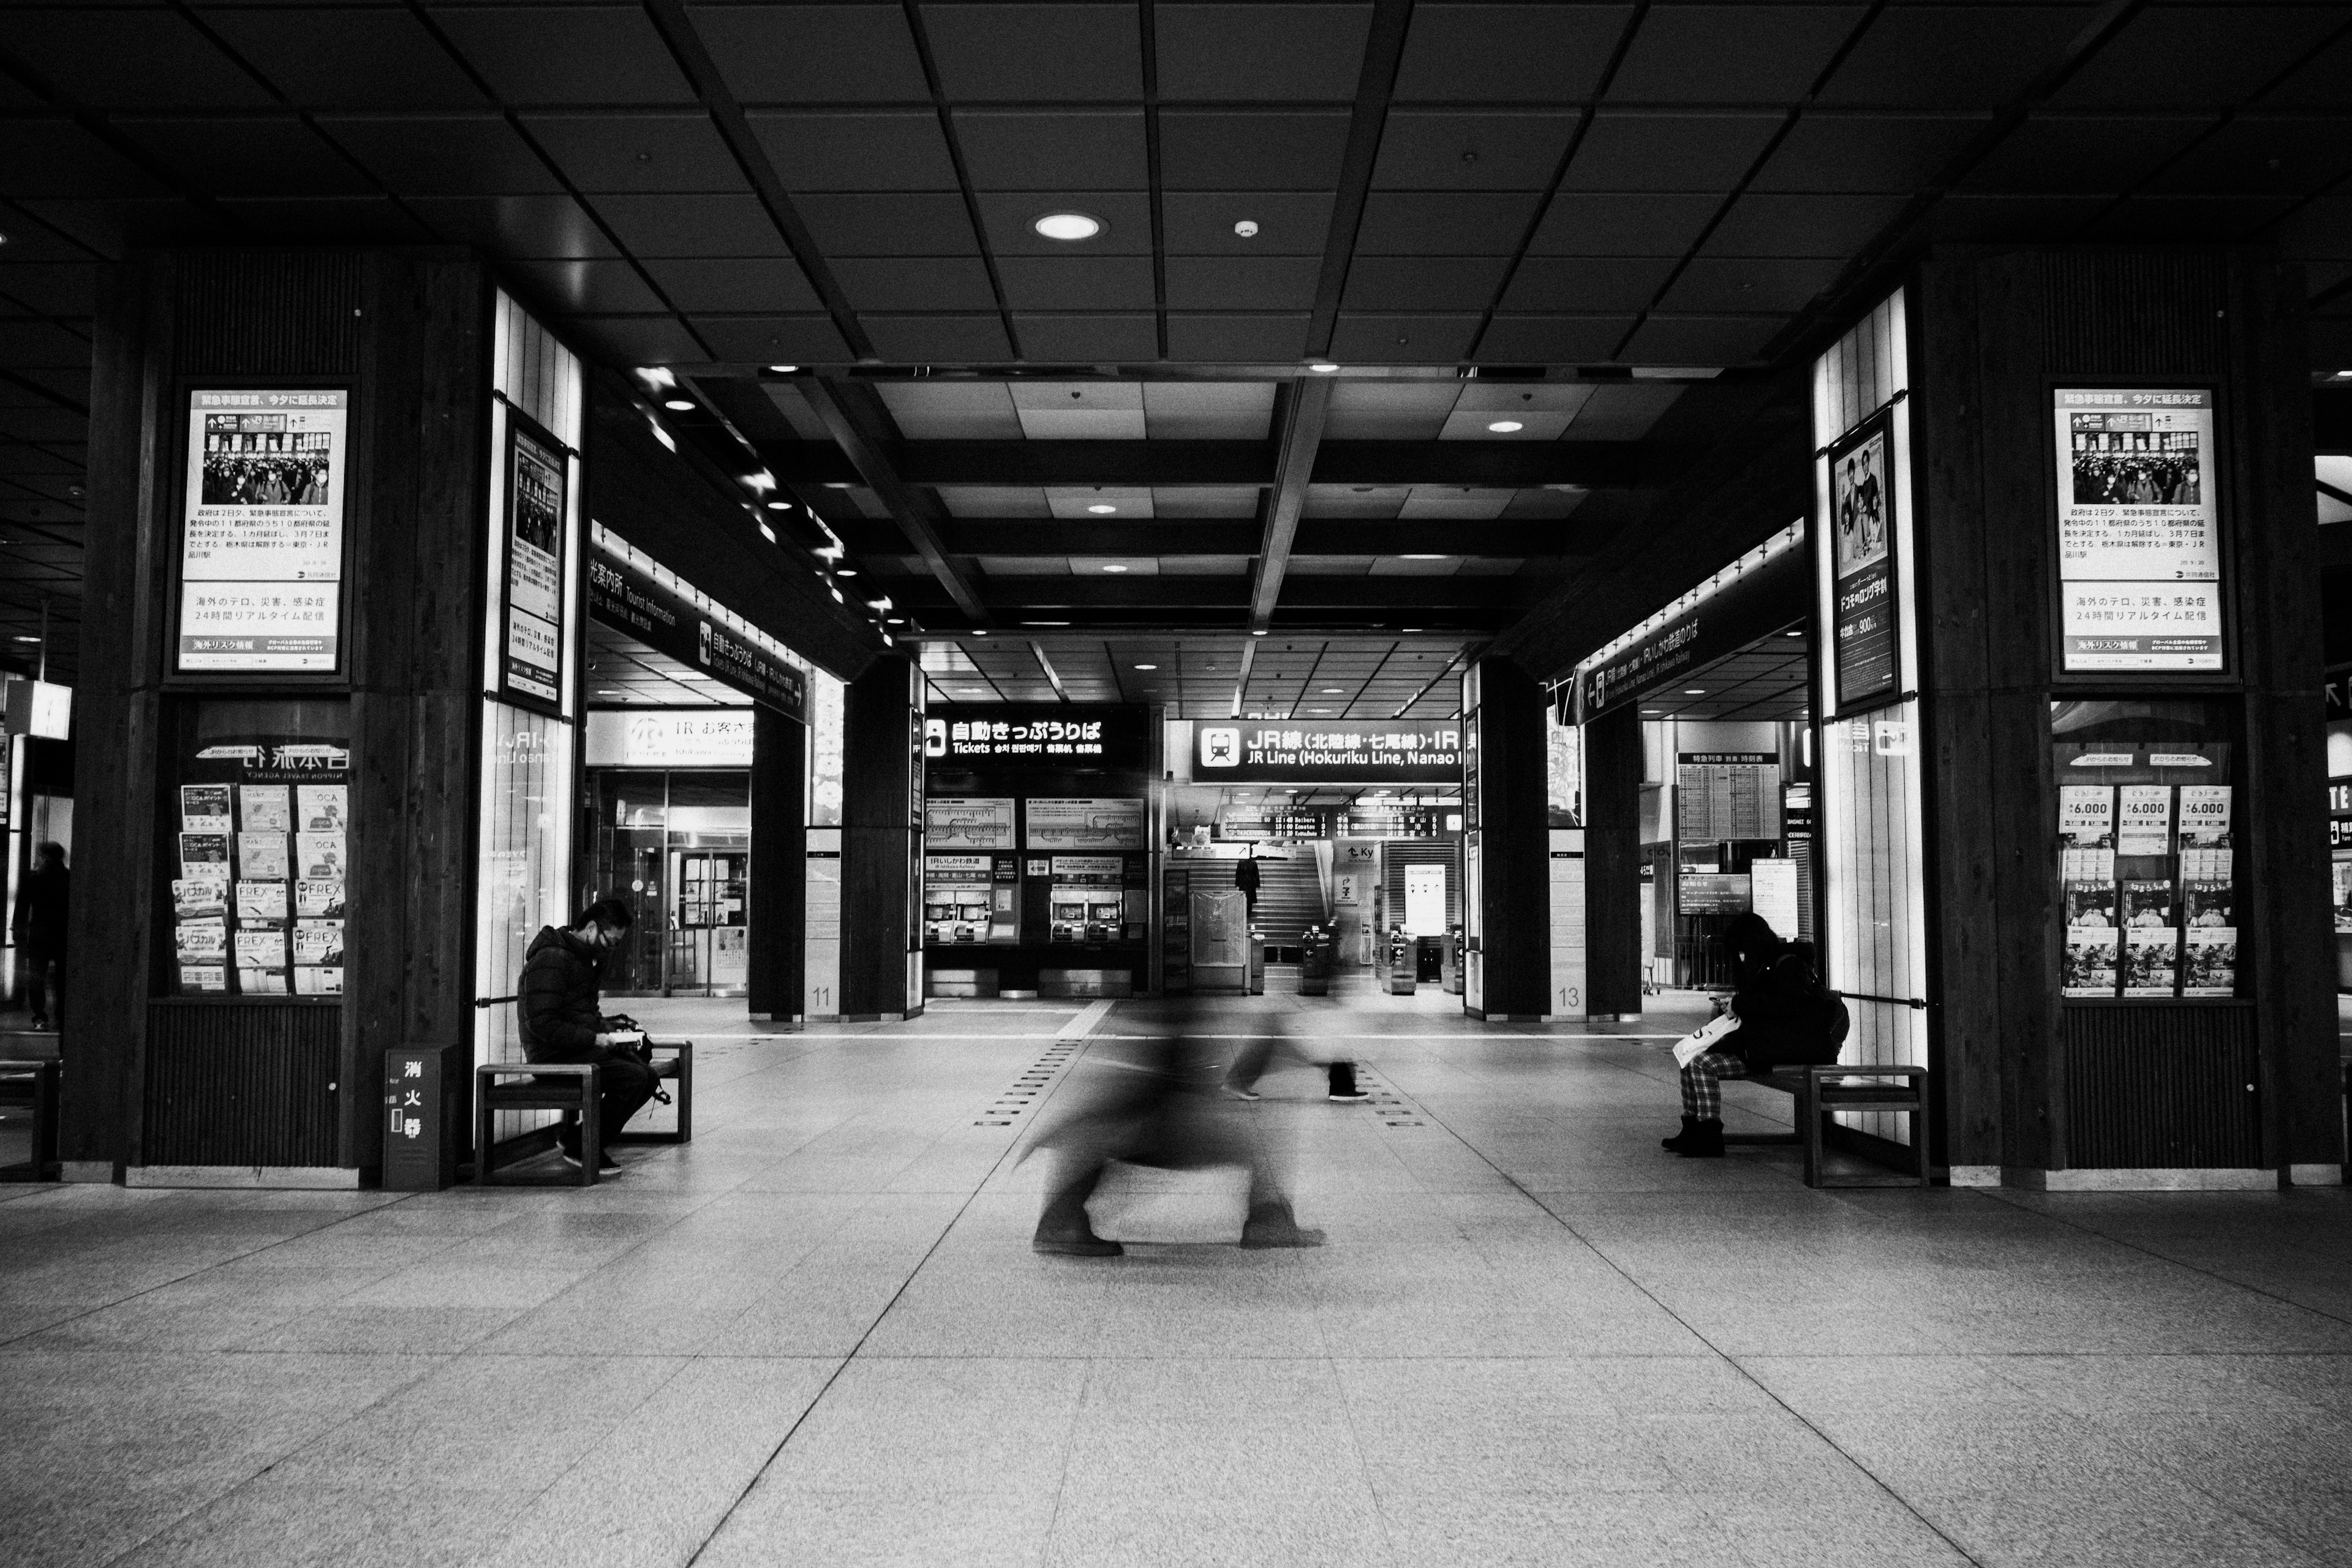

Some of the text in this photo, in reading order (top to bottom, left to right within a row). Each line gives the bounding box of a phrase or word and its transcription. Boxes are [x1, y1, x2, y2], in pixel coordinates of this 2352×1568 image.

[196, 597, 325, 606] 海外のテロ、災害、感染症
[627, 586, 645, 611] Tourist
[646, 597, 676, 626] Information
[2076, 597, 2206, 607] 海外のテロ、災害、感染症
[195, 611, 324, 621] 24時間リアルタイム配信
[2076, 611, 2206, 621] 24時間リアルタイム配信
[194, 639, 253, 650] 海外リスク情報
[714, 632, 752, 668] 自動きっぷうりば
[2078, 639, 2138, 650] 海外リスク情報
[677, 722, 693, 734] IR
[952, 722, 1101, 741] 自動きっぷうりば
[952, 742, 990, 753] Tickets
[1248, 750, 1455, 766] JR Line (Hokuriku Line, Nanao
[2075, 803, 2106, 813] 6,000
[2132, 803, 2165, 813] 6,000
[2191, 803, 2223, 813] 6,000
[1361, 848, 1373, 858] Ky
[239, 887, 267, 897] FREX
[309, 884, 341, 896] FREX
[185, 933, 216, 944] パスカル
[237, 936, 266, 946] FREX
[306, 931, 338, 943] FREX
[813, 987, 829, 1006] 11
[1559, 987, 1579, 1008] 13
[404, 1061, 422, 1139] 消火器
